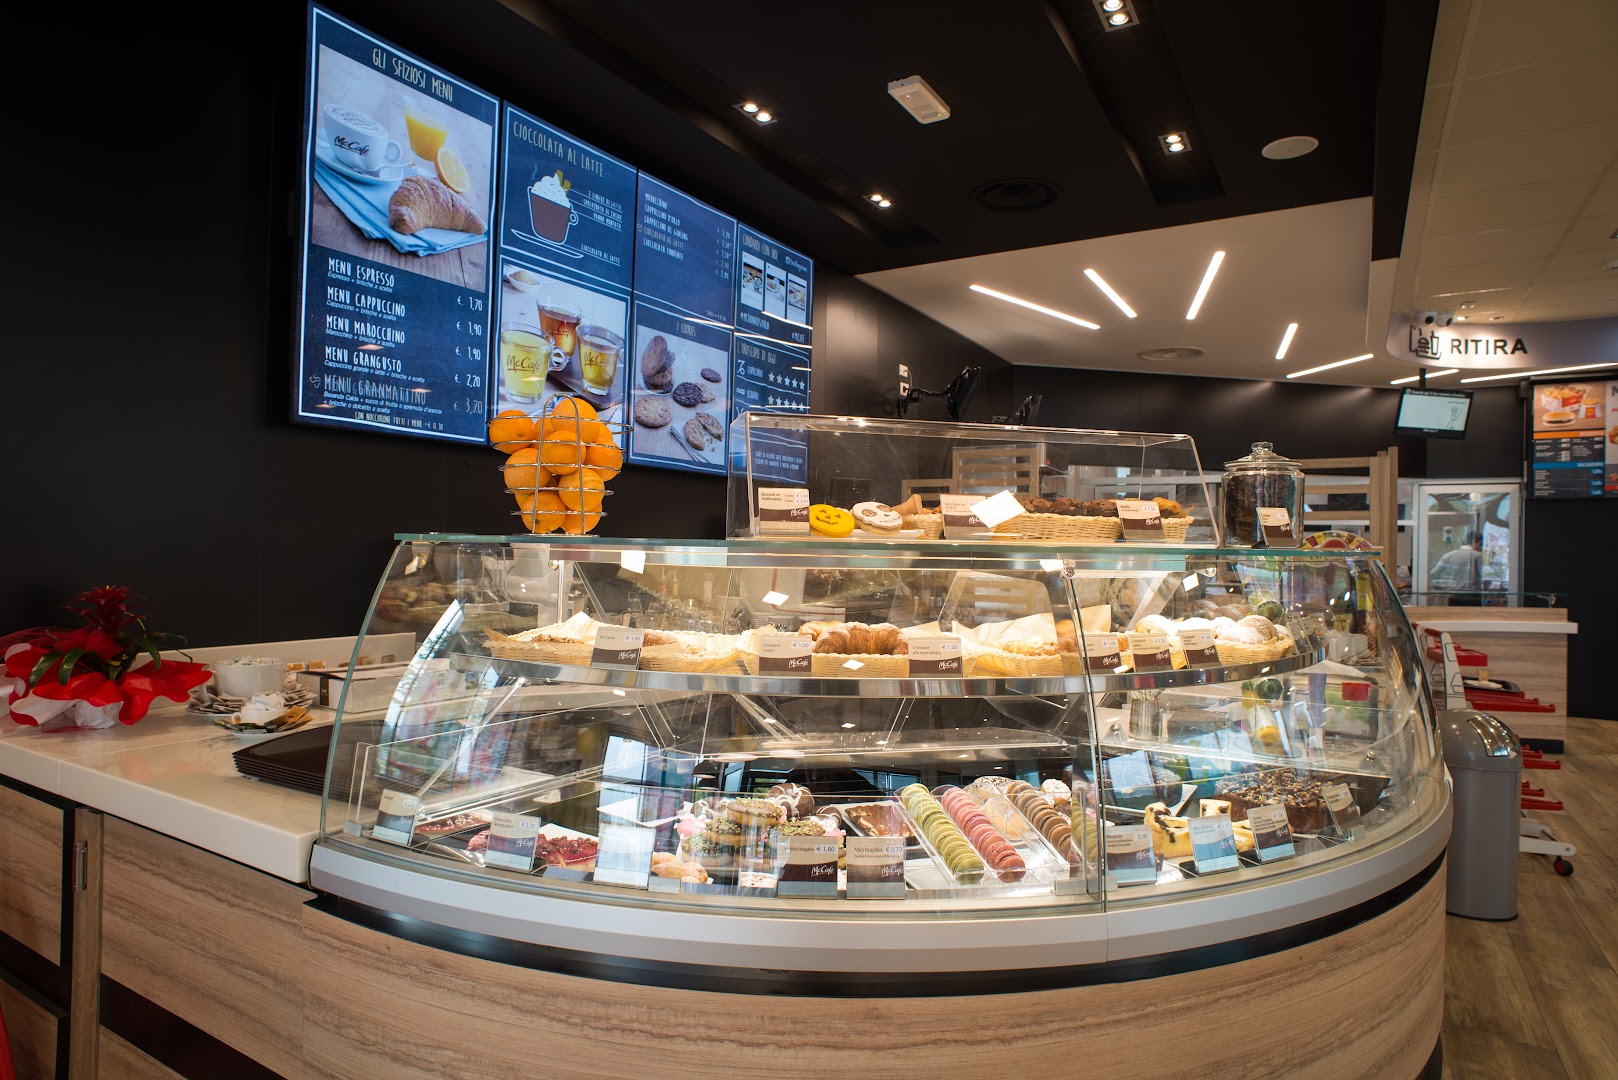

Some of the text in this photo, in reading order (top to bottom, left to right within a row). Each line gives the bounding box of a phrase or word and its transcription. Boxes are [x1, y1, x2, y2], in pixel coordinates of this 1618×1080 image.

[372, 48, 453, 102] GLI SFIZIOSI MENU
[334, 135, 370, 156] McCafé
[513, 121, 604, 178] CIOCCOLATA AL LATTE
[328, 257, 395, 288] MENU ESPRESSO
[327, 270, 350, 282] Espresso
[356, 279, 374, 288] brioche
[378, 285, 393, 293] scelta
[327, 285, 406, 317] MENU CAPPUCCINO
[469, 296, 483, 311] 1,70
[326, 299, 355, 312] Cappuccino
[360, 308, 378, 317] brioche
[382, 314, 397, 322] scelta
[326, 314, 405, 344] MENU MAROCCHINO
[468, 321, 482, 336] 1,90
[680, 322, 696, 337] COOKIES
[325, 328, 353, 339] Marocchino
[358, 336, 376, 344] brioche
[381, 340, 396, 348] scelta
[1450, 338, 1528, 355] RITIRA
[325, 345, 402, 372] MENU GRANGUSTO
[467, 346, 481, 361] 1,90
[324, 359, 352, 370] Cappuccino
[391, 372, 408, 380] brioche
[506, 354, 542, 374] McCafé
[324, 373, 352, 394] MENU
[466, 373, 481, 388] 2,20
[323, 391, 344, 400] Bevanda
[385, 400, 399, 408] frutta
[403, 404, 423, 412] spremuta
[328, 400, 347, 408] brioche
[352, 403, 372, 411] dolcetto
[376, 406, 391, 414] scelta
[466, 397, 483, 414] 3,70
[354, 411, 365, 420] CON
[411, 419, 422, 428] MENU
[618, 650, 637, 660] McCafé
[788, 658, 809, 668] McCafé
[1102, 657, 1119, 666] McCafé
[938, 660, 959, 670] McCafé
[516, 838, 534, 848] McCafé
[810, 864, 834, 877] McCafé
[880, 866, 904, 878] McCafé
